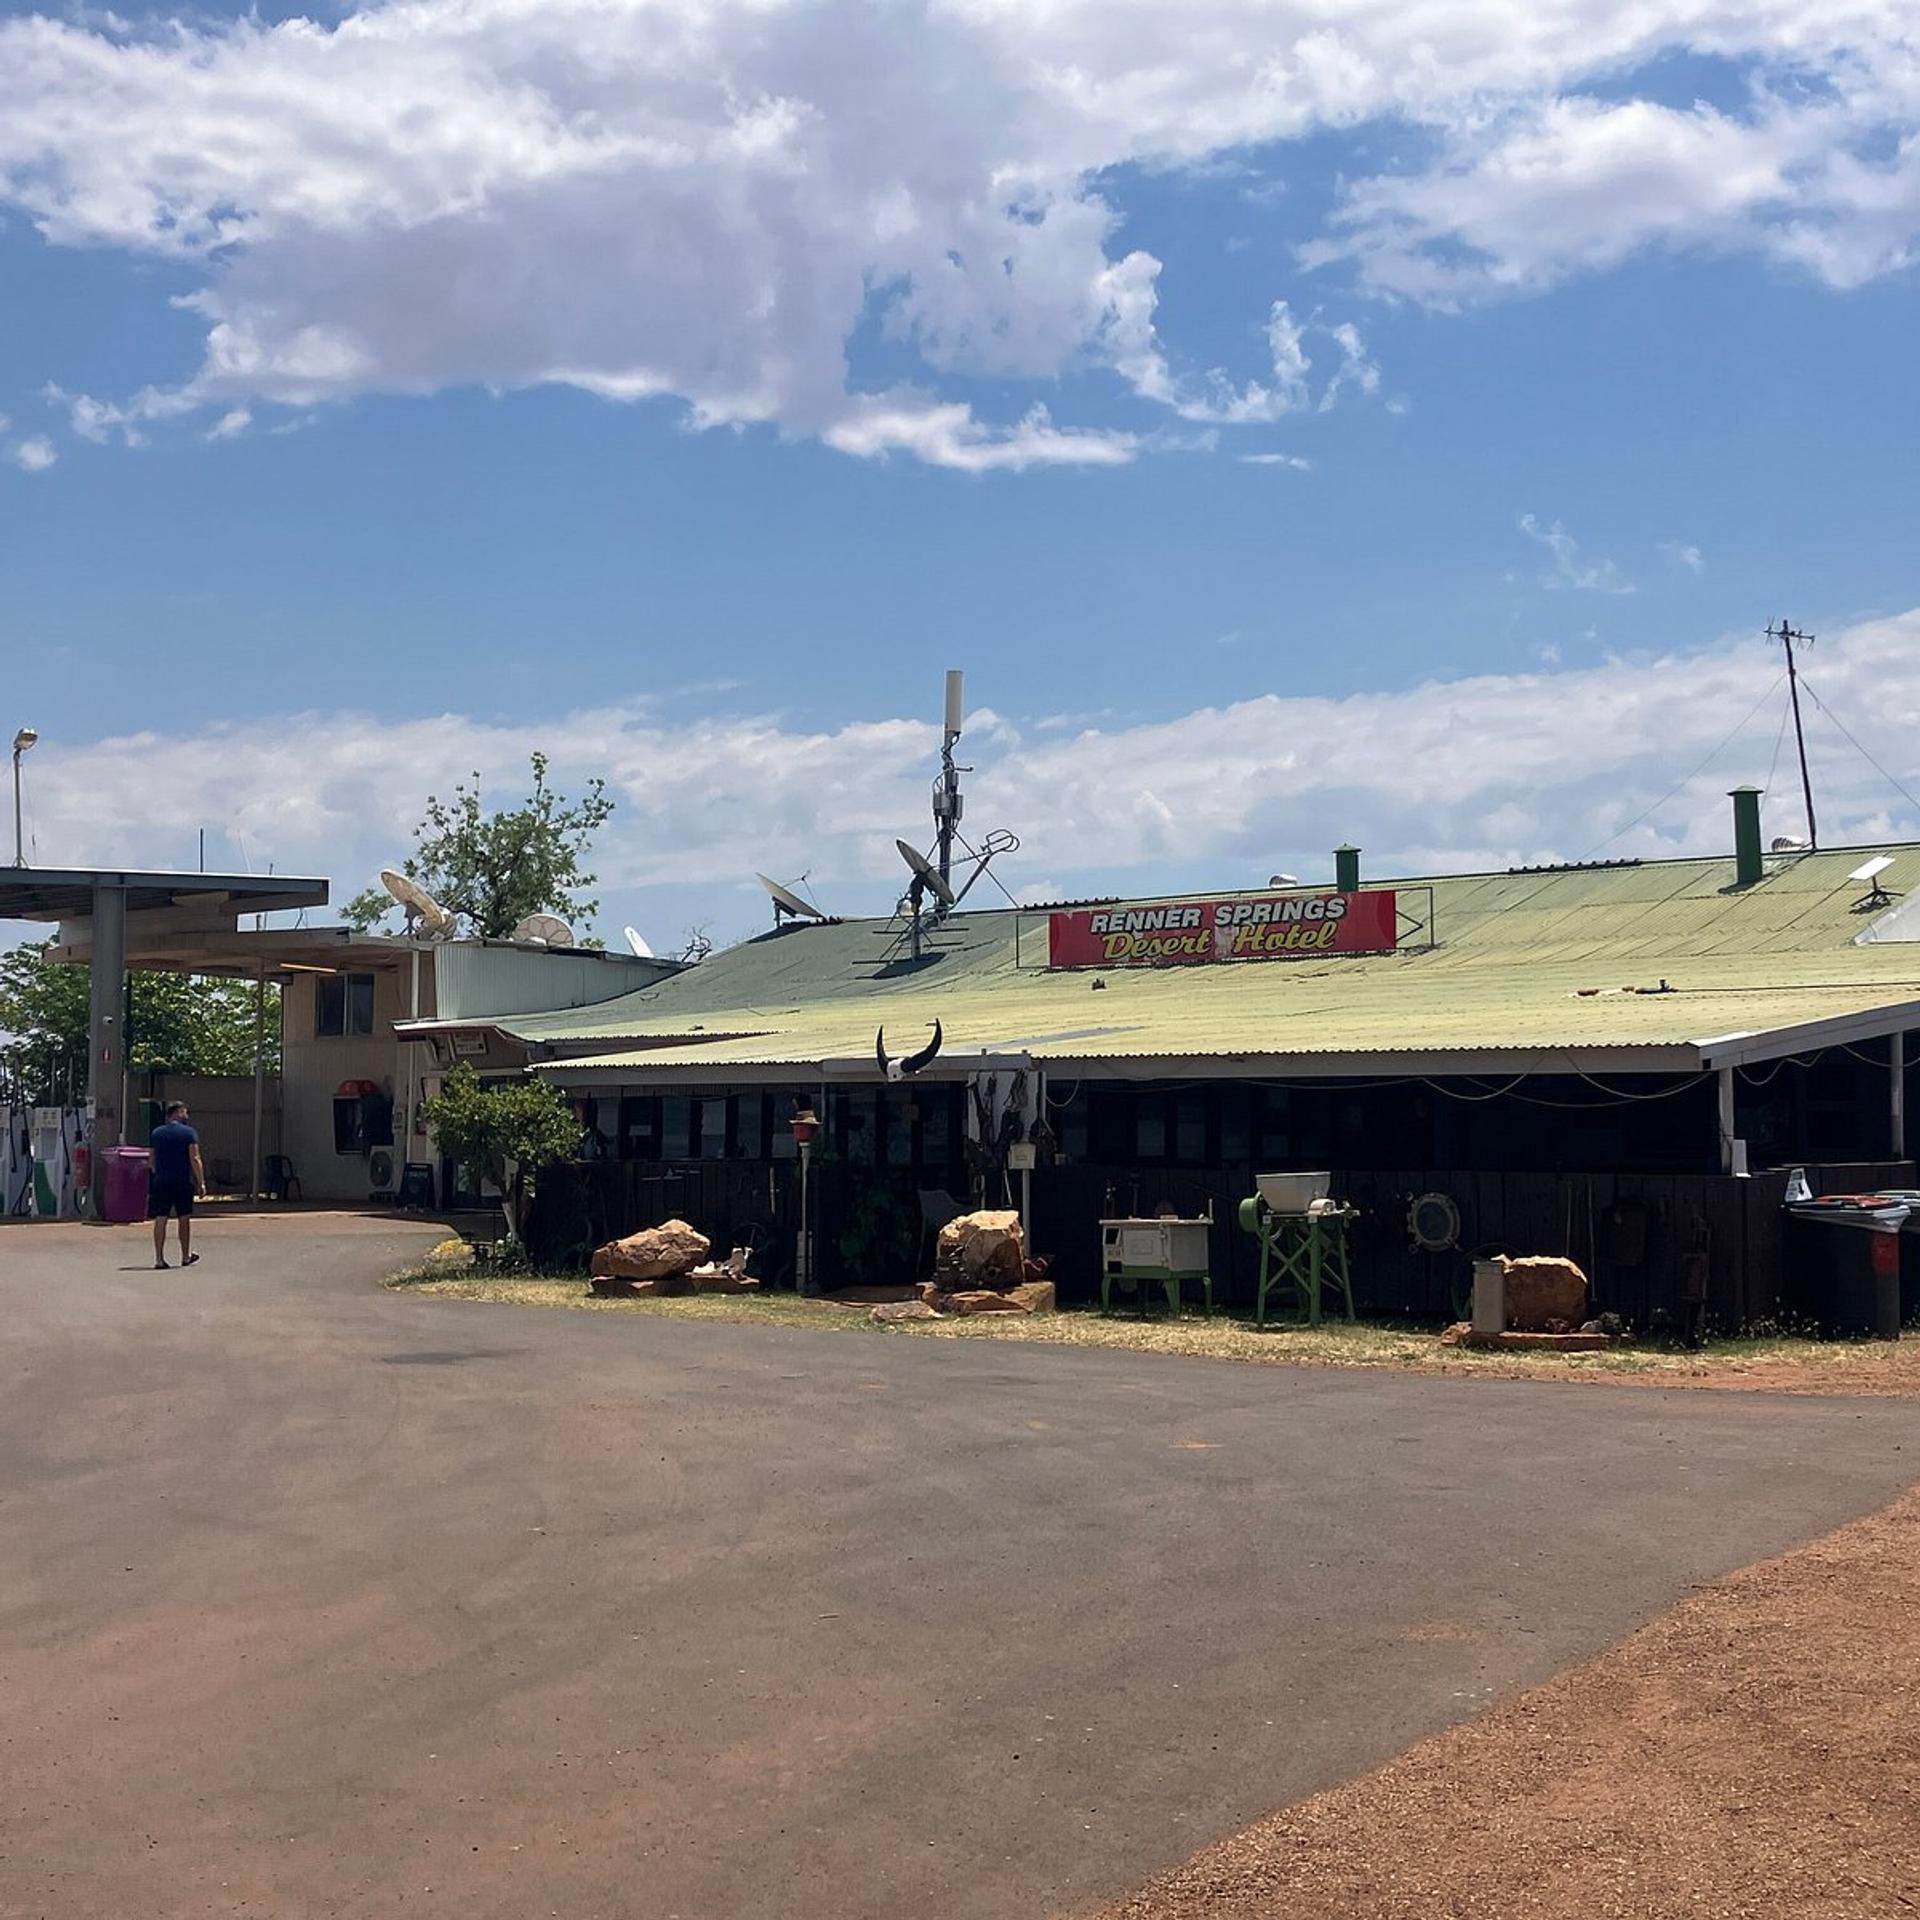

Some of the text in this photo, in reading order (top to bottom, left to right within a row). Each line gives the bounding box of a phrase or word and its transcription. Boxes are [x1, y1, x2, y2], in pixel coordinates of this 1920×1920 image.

[1091, 899, 1346, 933] RENNER SPRINGS
[1102, 921, 1338, 960] Desert Hotel
